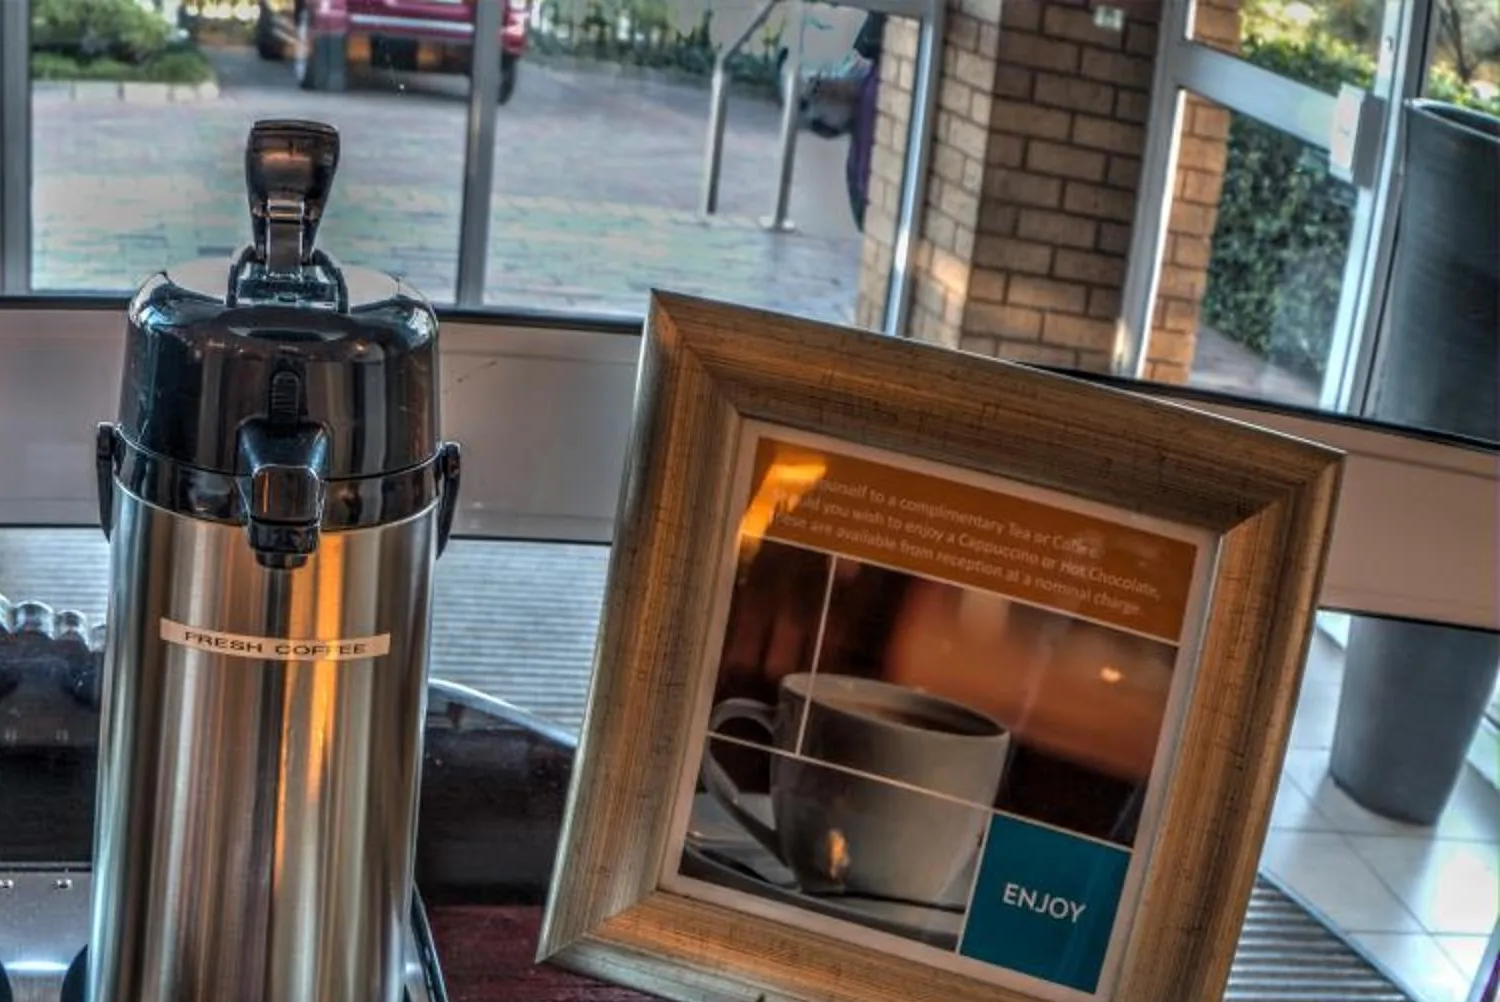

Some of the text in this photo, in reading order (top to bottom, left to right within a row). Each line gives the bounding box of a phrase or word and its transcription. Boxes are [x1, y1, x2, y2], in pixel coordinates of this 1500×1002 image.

[869, 489, 885, 503] to
[1008, 521, 1032, 540] Tea
[1033, 533, 1049, 546] or
[810, 519, 833, 534] are
[900, 538, 934, 560] from
[823, 501, 849, 518] you
[888, 515, 902, 530] to
[904, 520, 944, 542] enjoy
[1041, 556, 1057, 569] or
[1060, 561, 1086, 577] Hot
[185, 631, 366, 655] FRESH COFFEE
[1002, 882, 1086, 923] ENJOY
